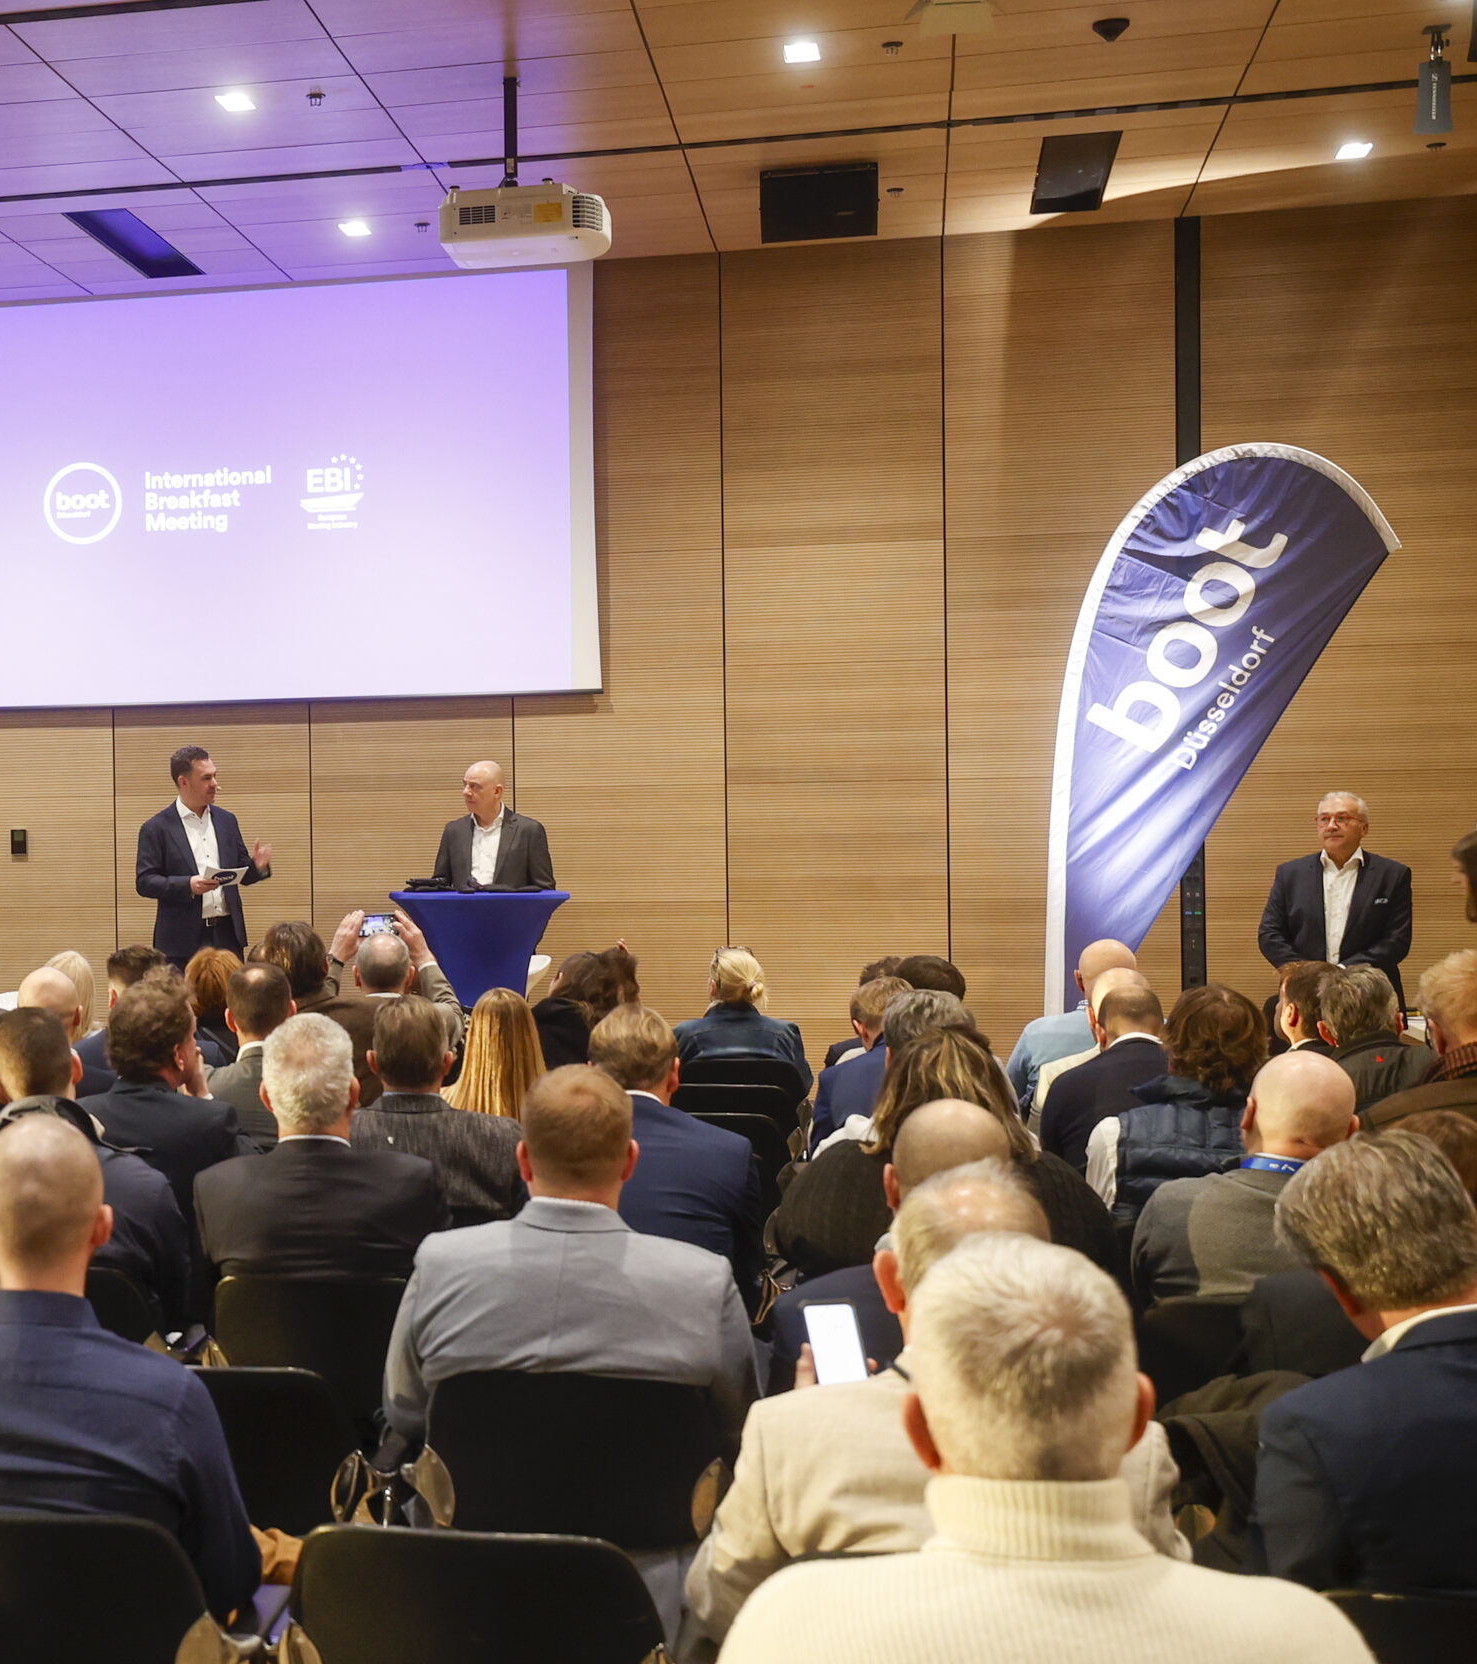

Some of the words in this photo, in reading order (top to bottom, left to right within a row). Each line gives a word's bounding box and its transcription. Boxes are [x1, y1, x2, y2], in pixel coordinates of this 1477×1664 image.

[144, 464, 272, 490] International
[306, 467, 351, 493] EBI
[55, 489, 111, 511] boot
[144, 488, 241, 511] Breakfast
[145, 510, 229, 533] Meeting
[1086, 518, 1289, 753] boot
[1173, 625, 1276, 771] Düsseldorf
